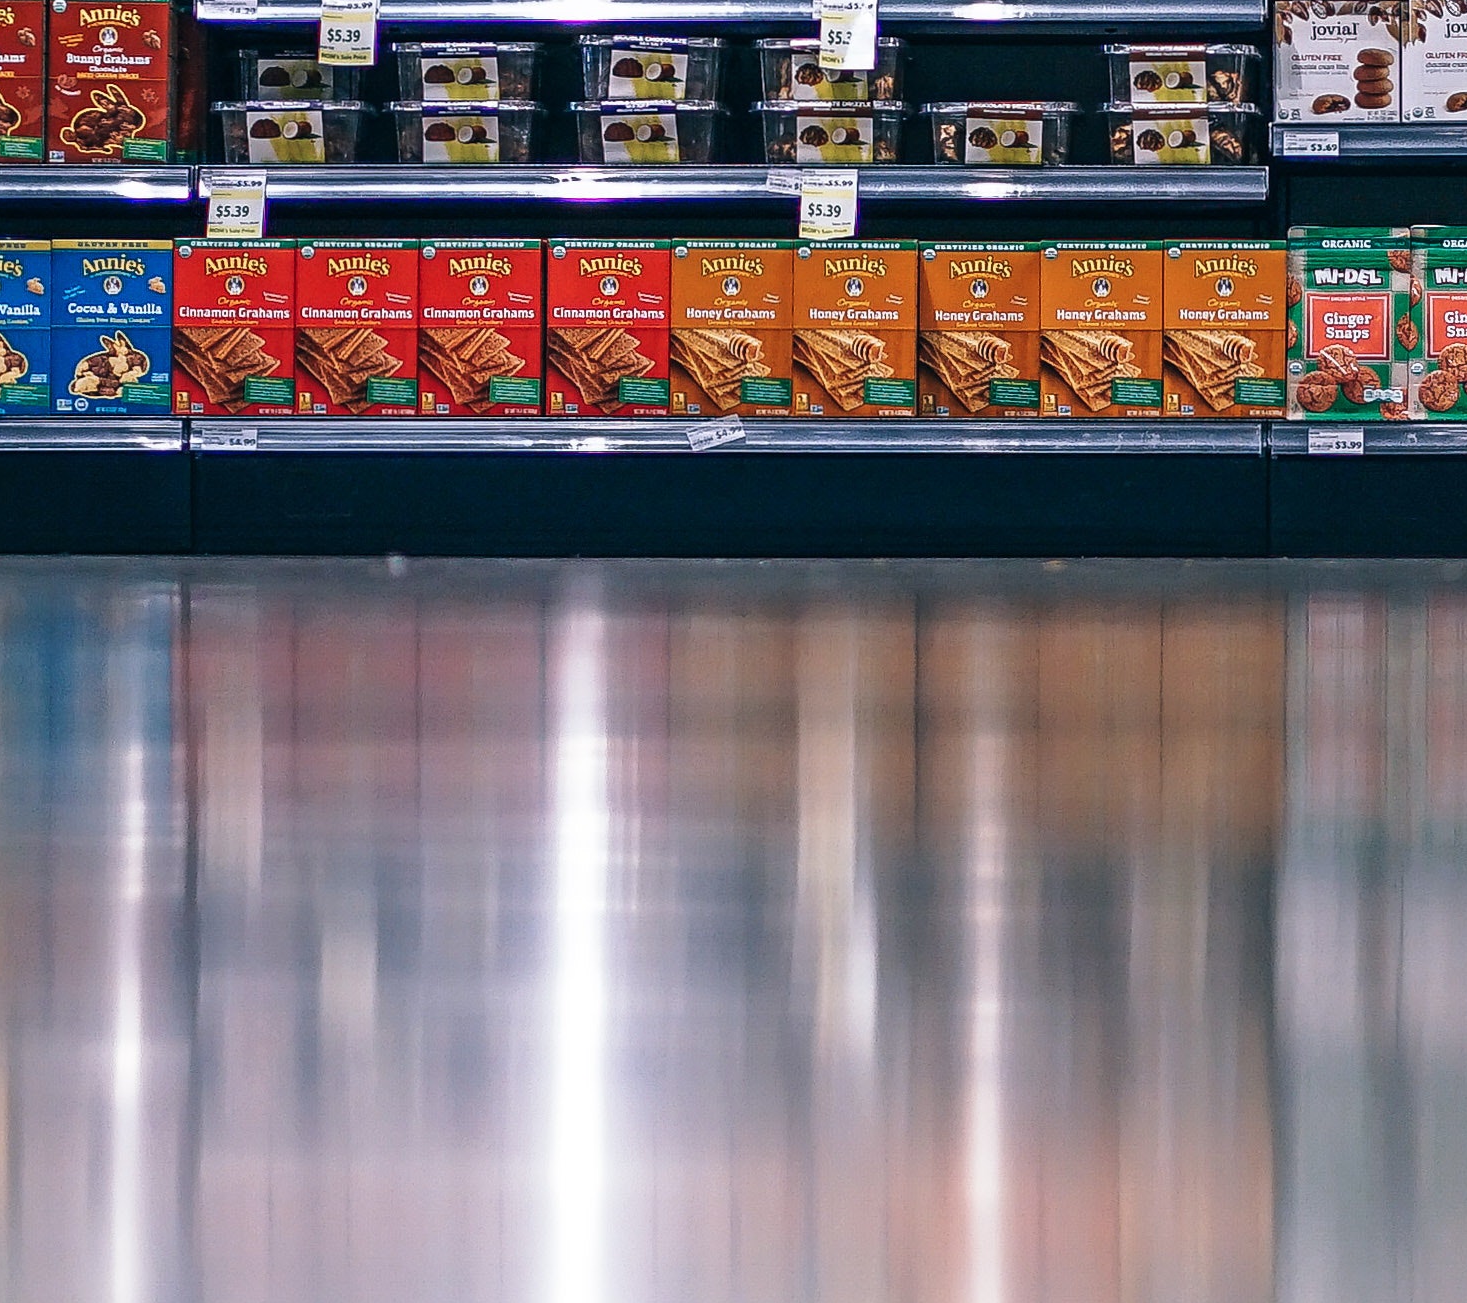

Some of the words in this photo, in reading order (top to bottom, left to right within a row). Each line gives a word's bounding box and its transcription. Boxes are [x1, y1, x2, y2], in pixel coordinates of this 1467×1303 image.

[327, 28, 361, 44] $5.39
[215, 204, 250, 219] $5.39
[448, 253, 512, 277] Annie's
[1071, 254, 1134, 277] Annie's
[301, 306, 357, 320] Cinnamon
[360, 306, 413, 320] Grahams
[1056, 308, 1093, 323] Honey
[1096, 308, 1146, 321] Grahams
